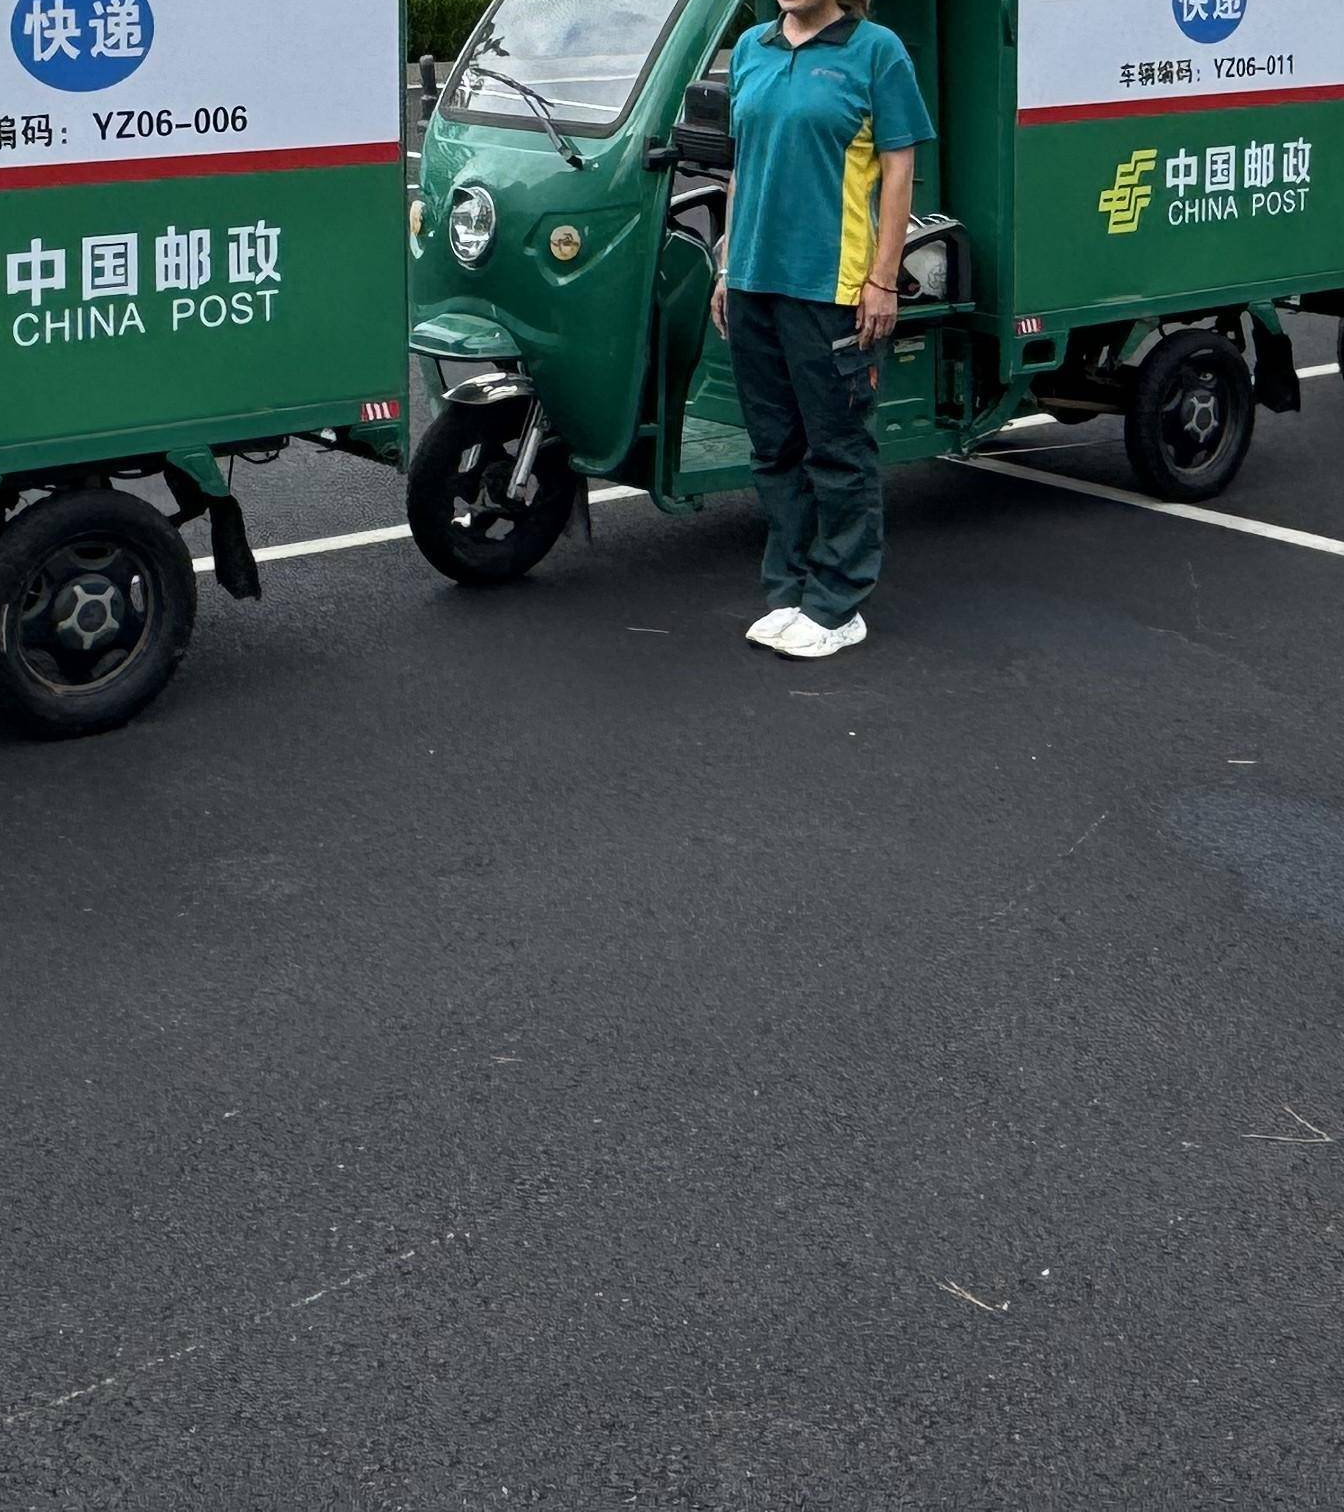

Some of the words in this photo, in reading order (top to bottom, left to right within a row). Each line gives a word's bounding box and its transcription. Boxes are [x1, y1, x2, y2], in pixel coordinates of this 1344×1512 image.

[1214, 54, 1295, 79] YZ06-011
[93, 105, 248, 140] YZ06-006
[1166, 137, 1312, 197] 中国邮政
[1168, 195, 1238, 225] CHINA
[1252, 188, 1310, 217] POST
[6, 219, 282, 306] 中国邮政
[12, 302, 145, 347] CHINA
[172, 289, 280, 331] POST
